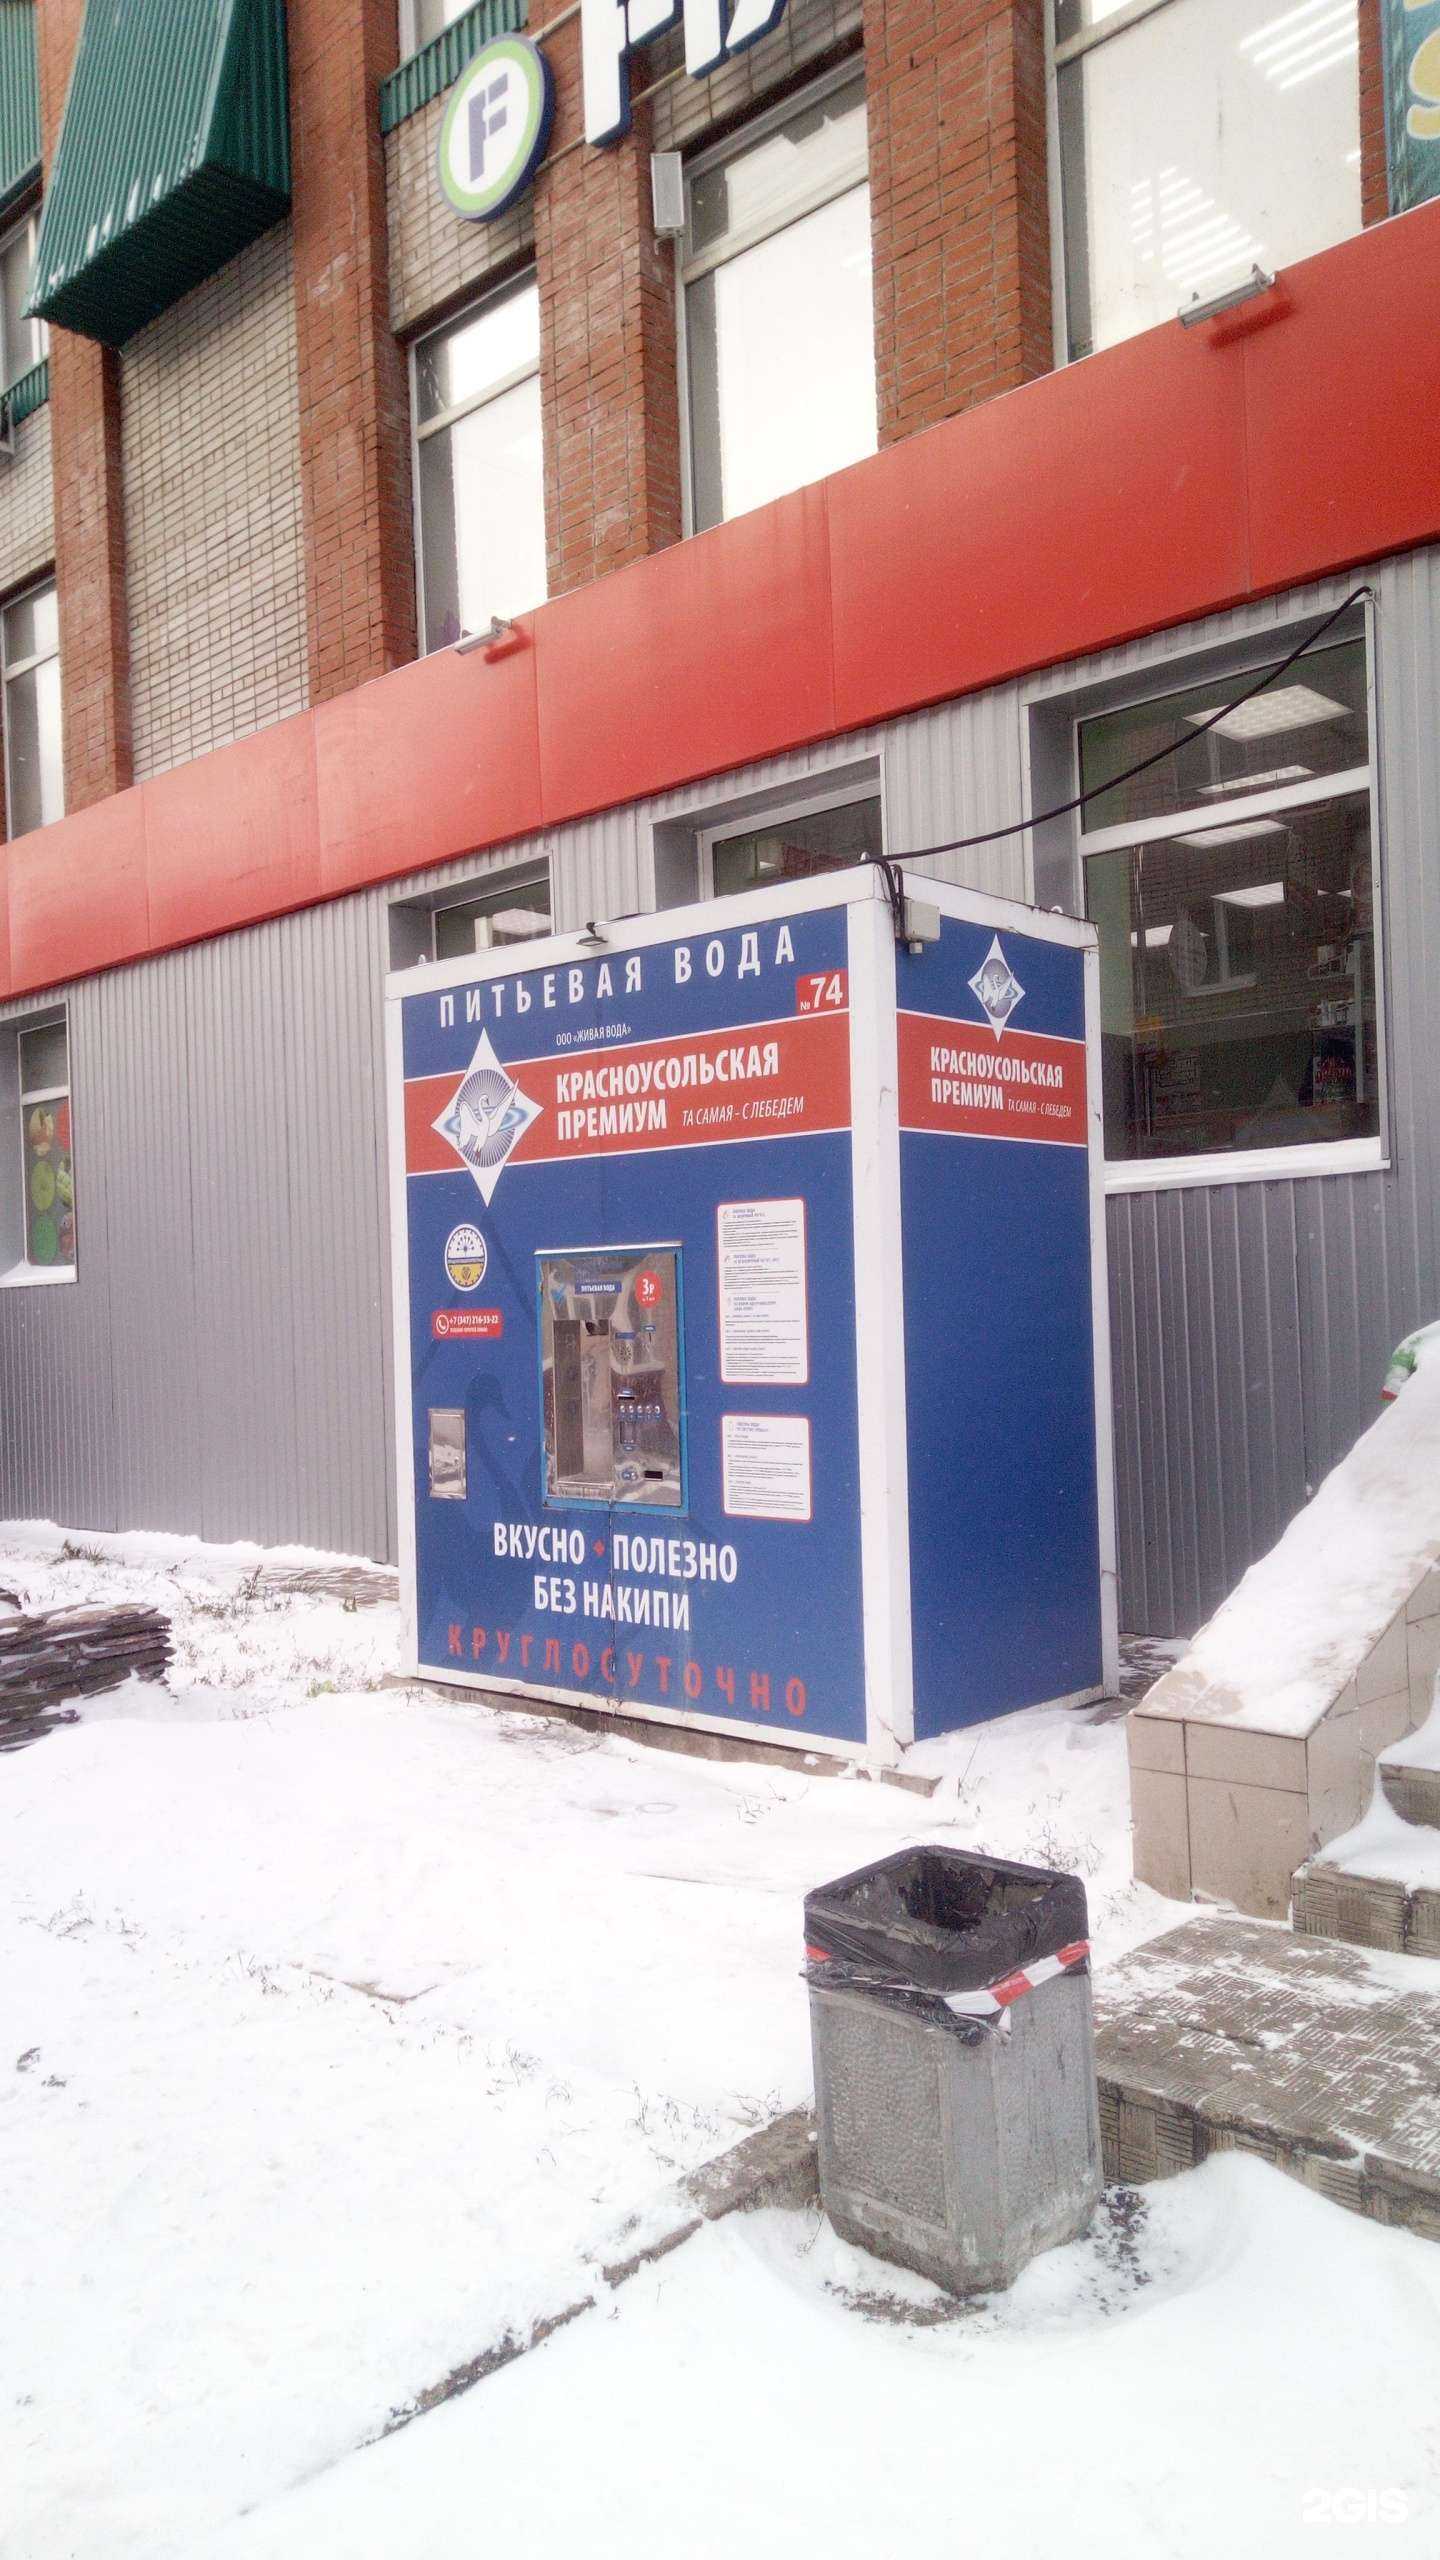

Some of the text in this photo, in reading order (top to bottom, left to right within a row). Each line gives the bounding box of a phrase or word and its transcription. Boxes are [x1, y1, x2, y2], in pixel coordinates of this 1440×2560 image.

[440, 925, 795, 1028] ПИТЬЕВАЯ ВОДА
[556, 1023, 632, 1046] ООО «ЖИВАЯ ВОДА»
[556, 1042, 779, 1104] КРАСНОУСОЛЬСКАЯ
[930, 1046, 1064, 1089] КРАСНОУСОЛЬСКАЯ
[682, 1109, 694, 1127] ТА
[696, 1104, 733, 1125] САМАЯ
[750, 1096, 804, 1119] ЛЕБЕДЕМ
[931, 1078, 1004, 1111] ПРЕМИУМ
[1016, 1099, 1037, 1114] САМАЯ
[1045, 1103, 1072, 1118] ЛЕБЕДЕМ
[557, 1099, 667, 1141] ПРЕМИУМ
[493, 1522, 738, 1584] ВКУСНО ПОЛЕЗНО
[534, 1575, 691, 1631] БЕЗ НАКИПИ
[449, 1623, 809, 1718] КРУГЛОСУТОЧНО
